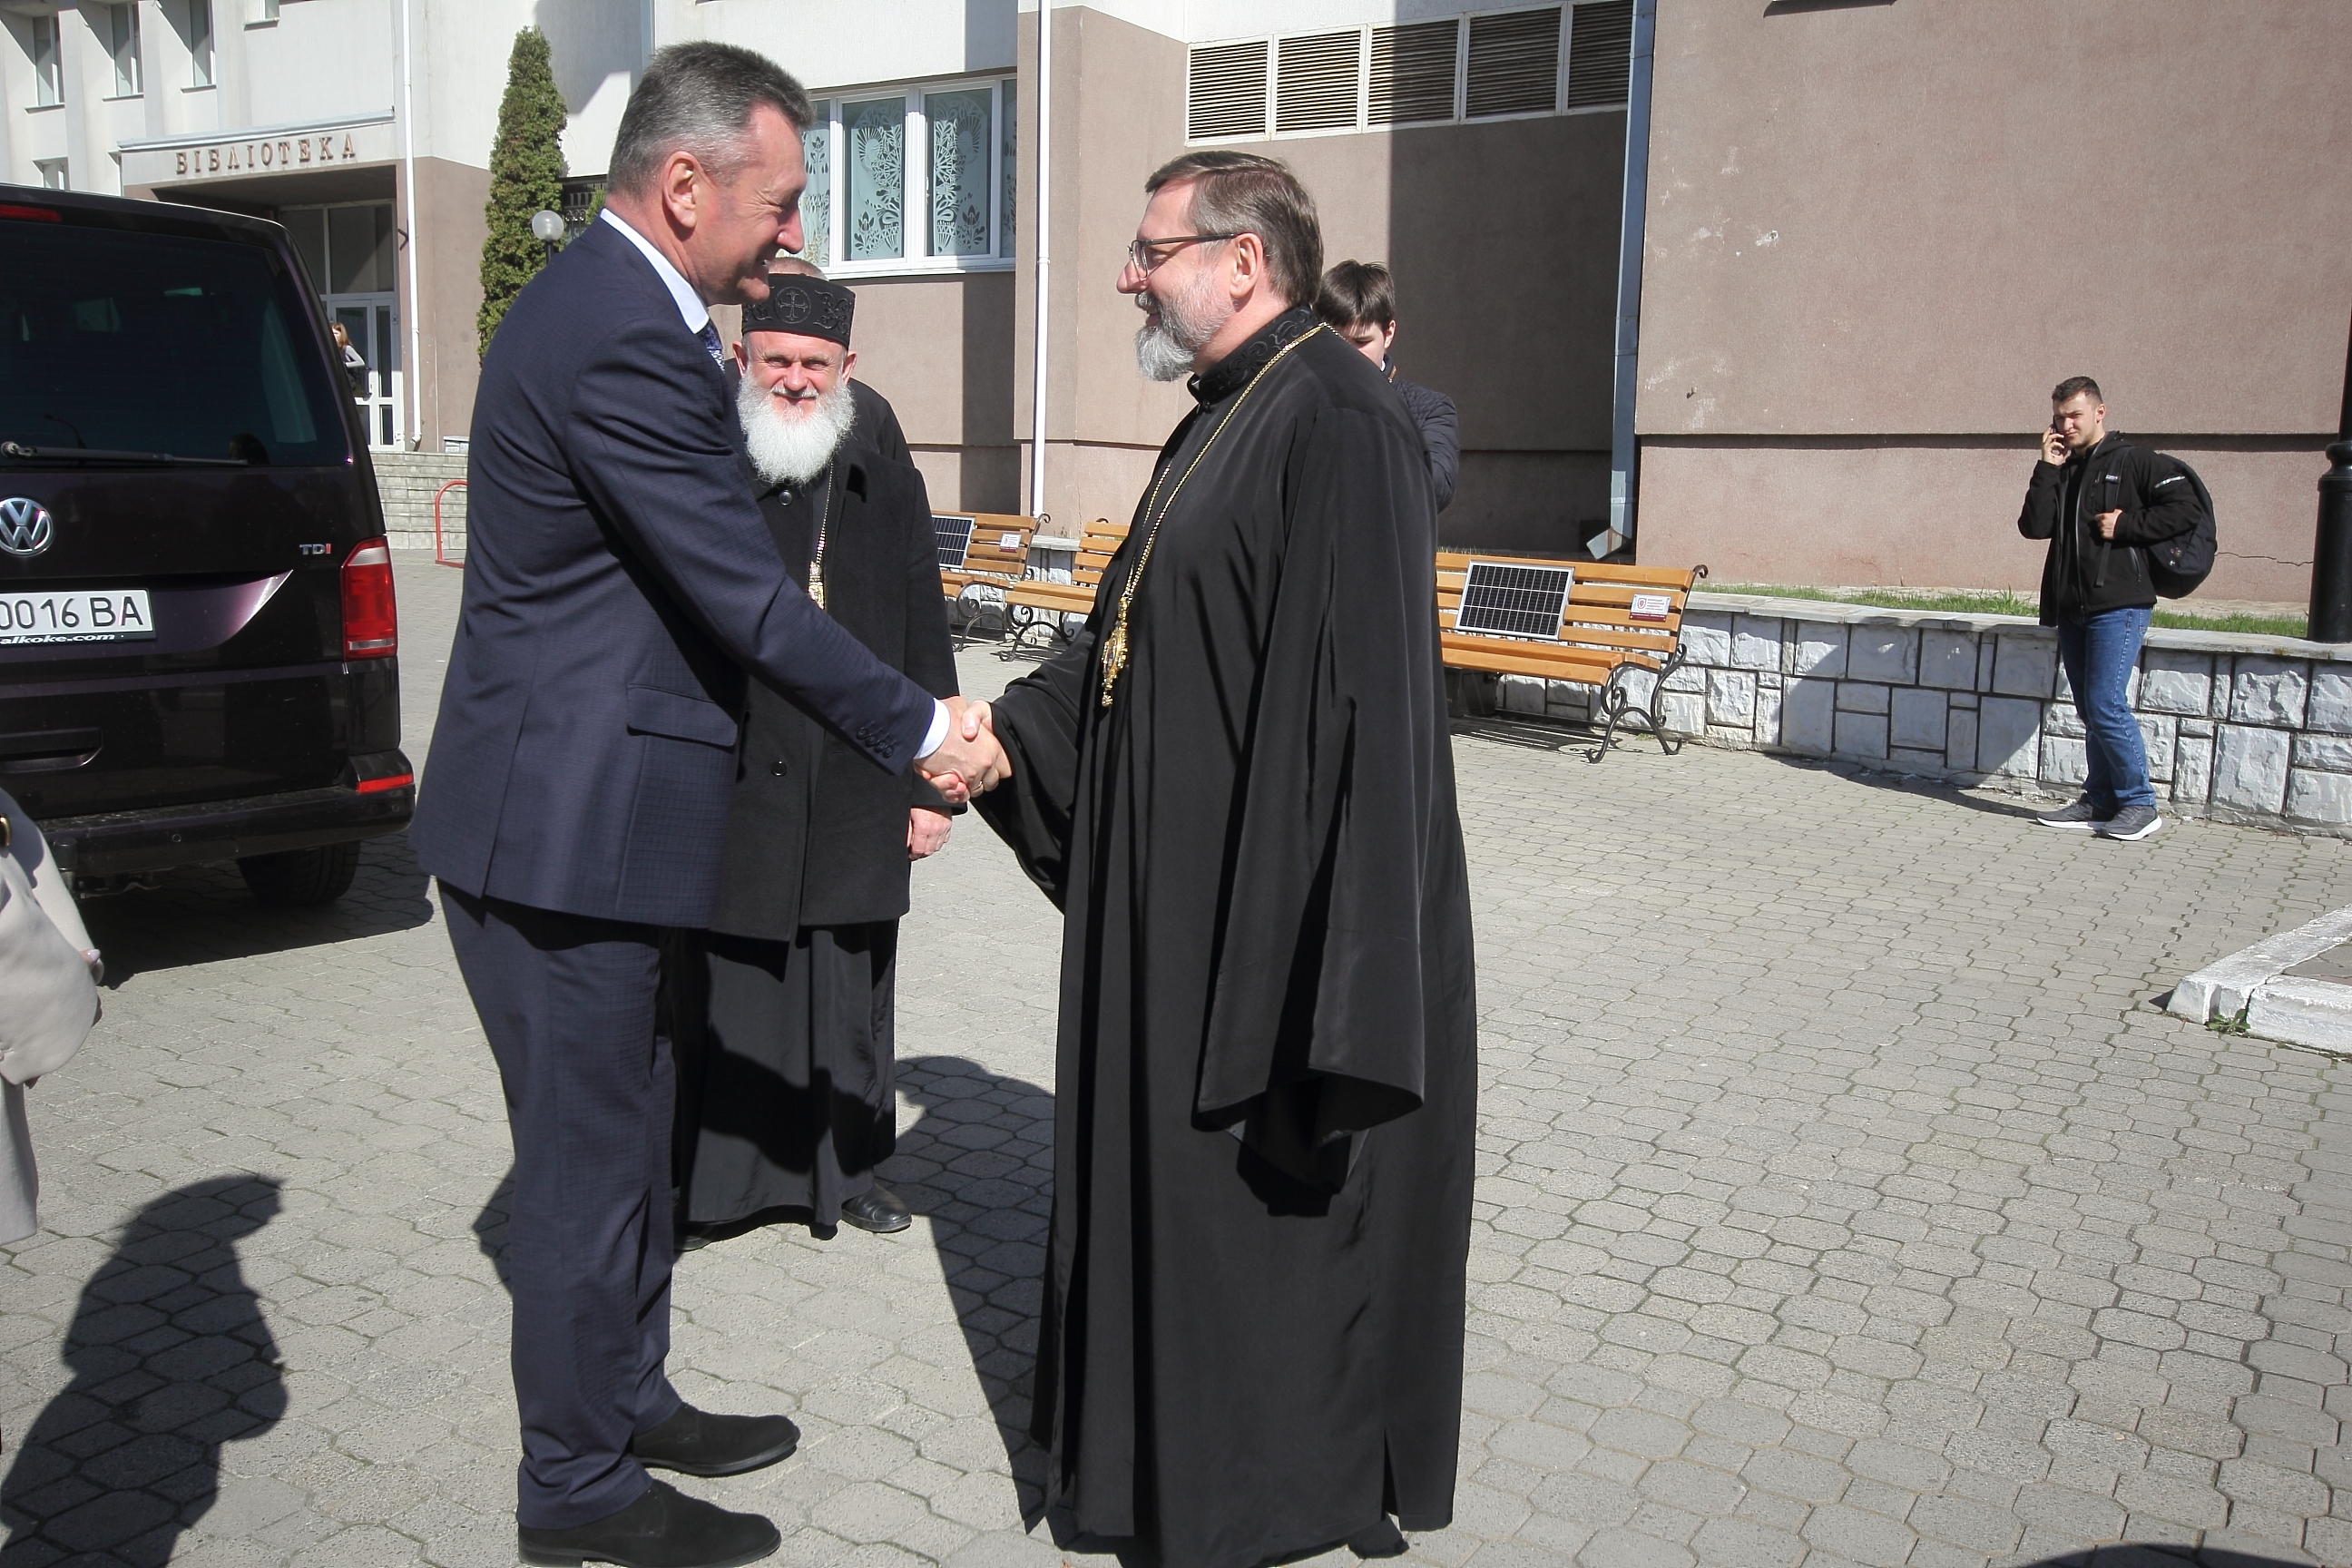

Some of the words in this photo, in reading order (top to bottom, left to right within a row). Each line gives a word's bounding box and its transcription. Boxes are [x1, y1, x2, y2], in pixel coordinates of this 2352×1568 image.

[175, 133, 356, 175] БІБЛІОТЕКА
[299, 543, 331, 555] TDI
[89, 596, 143, 628] BA
